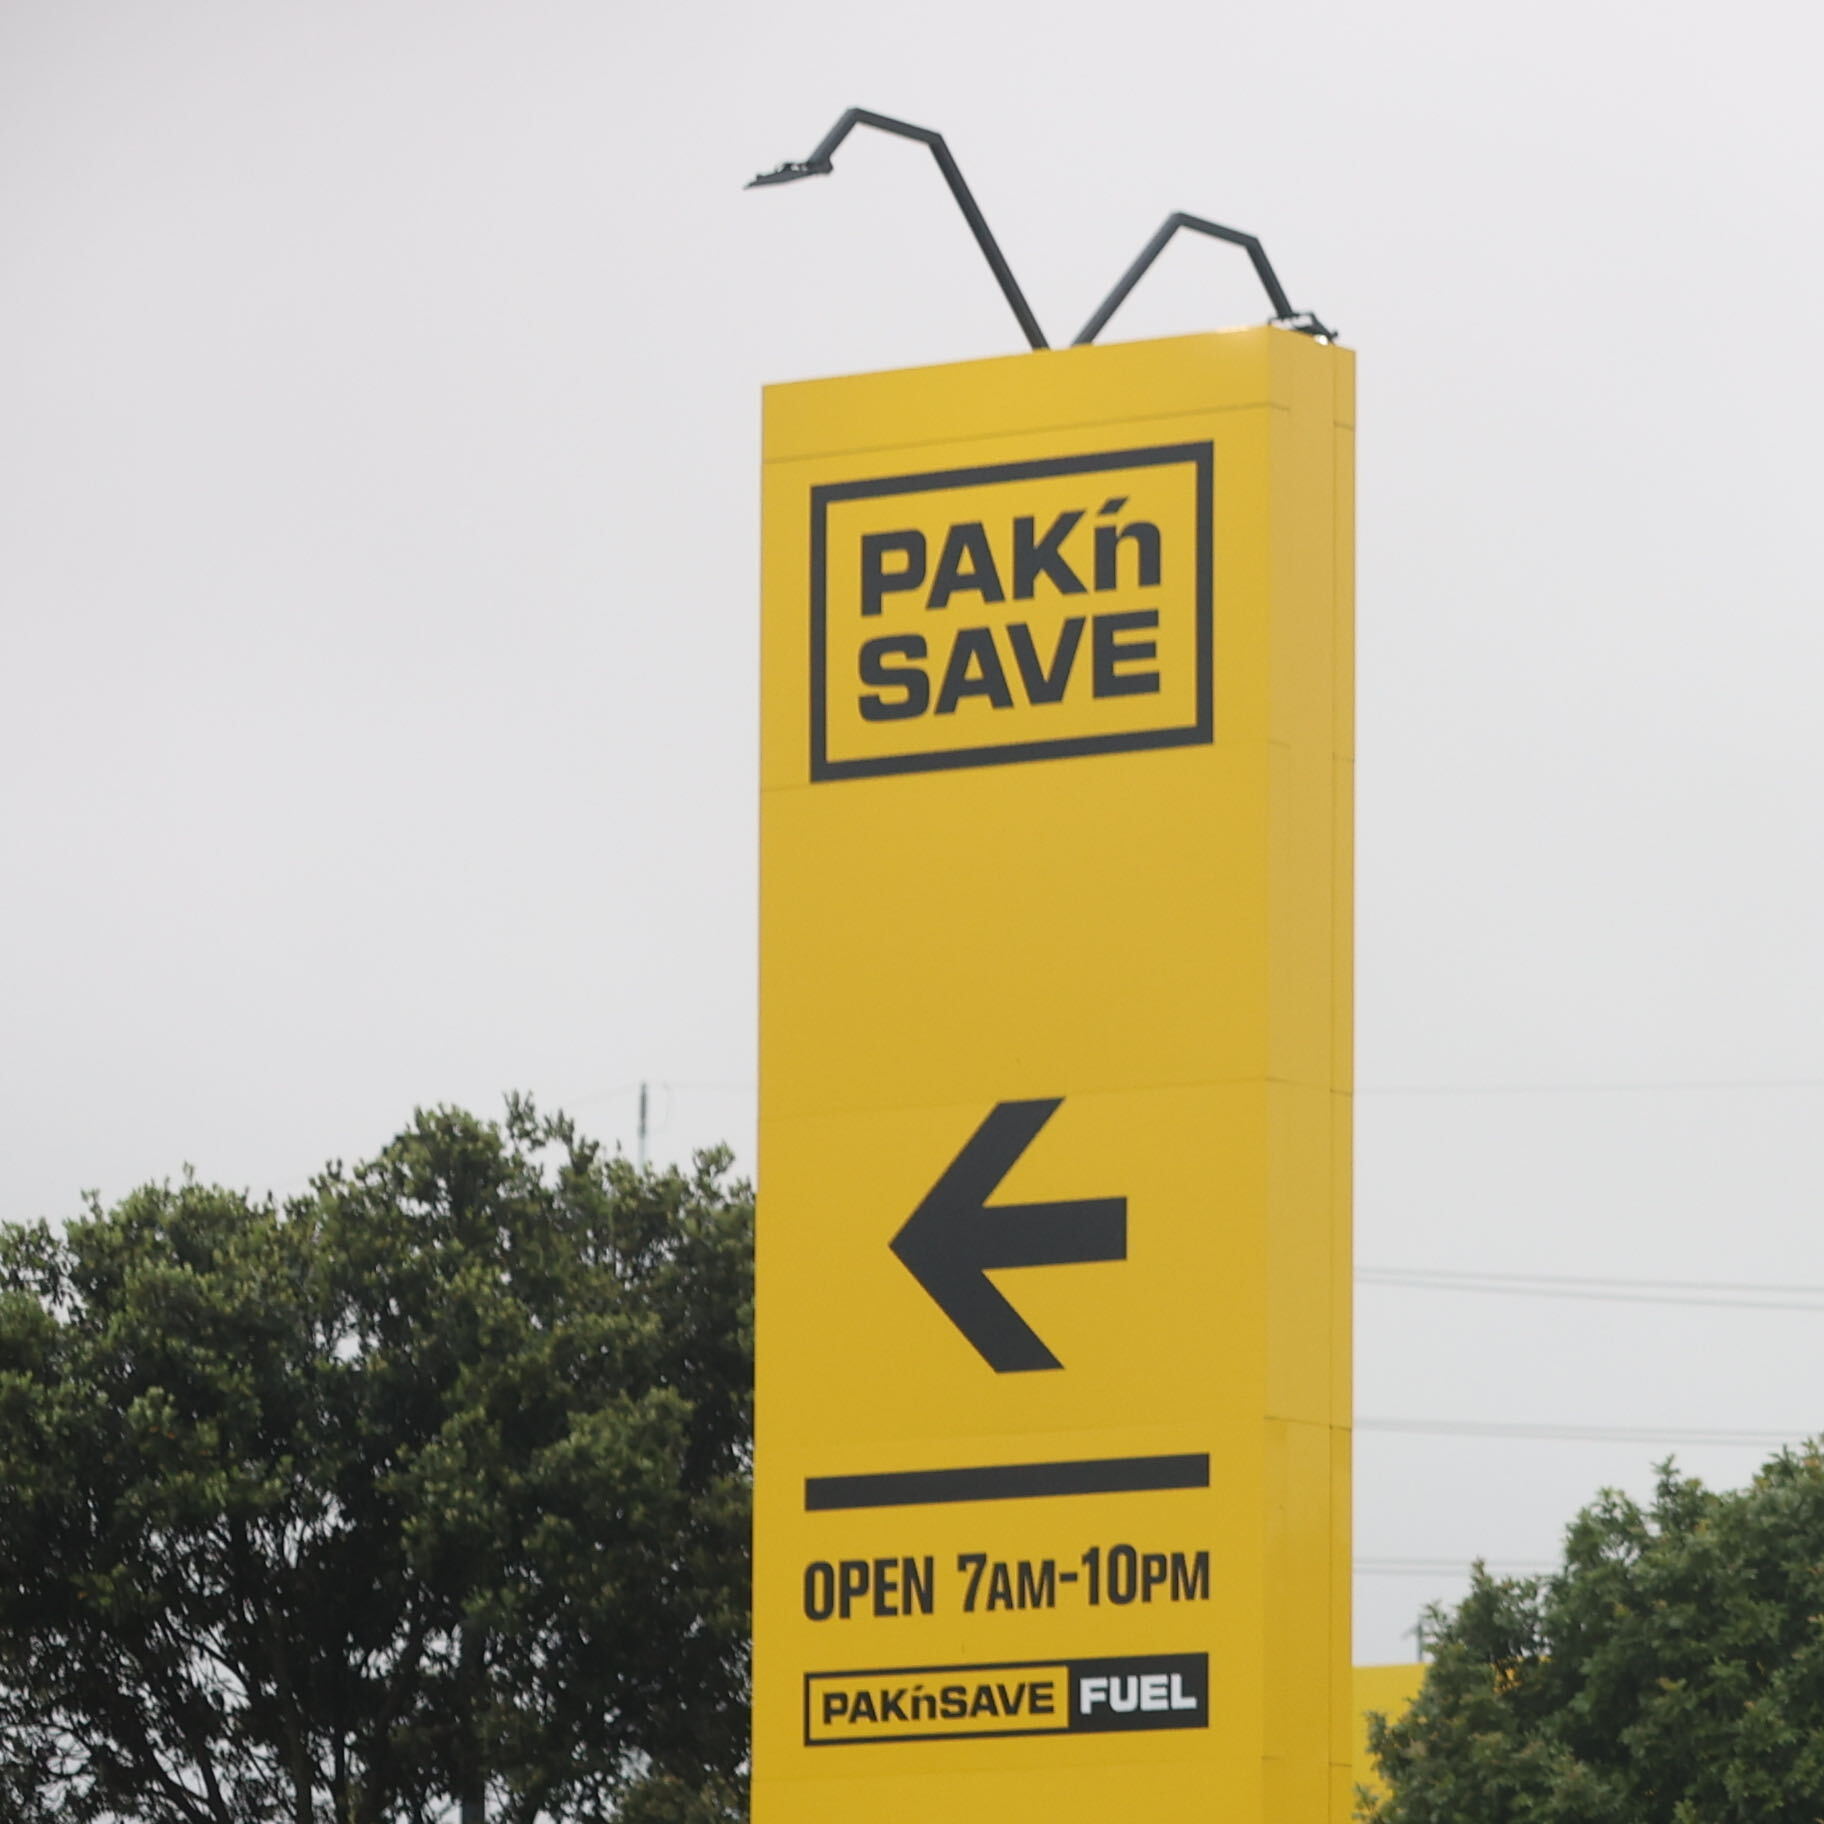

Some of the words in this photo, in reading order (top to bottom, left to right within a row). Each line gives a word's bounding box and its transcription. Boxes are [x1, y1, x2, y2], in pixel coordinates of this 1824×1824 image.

[857, 609, 1161, 723] SAVE
[804, 1555, 935, 1622] OPEN
[957, 1543, 1210, 1613] 7AM-10PM
[1079, 1672, 1198, 1715] FUEL
